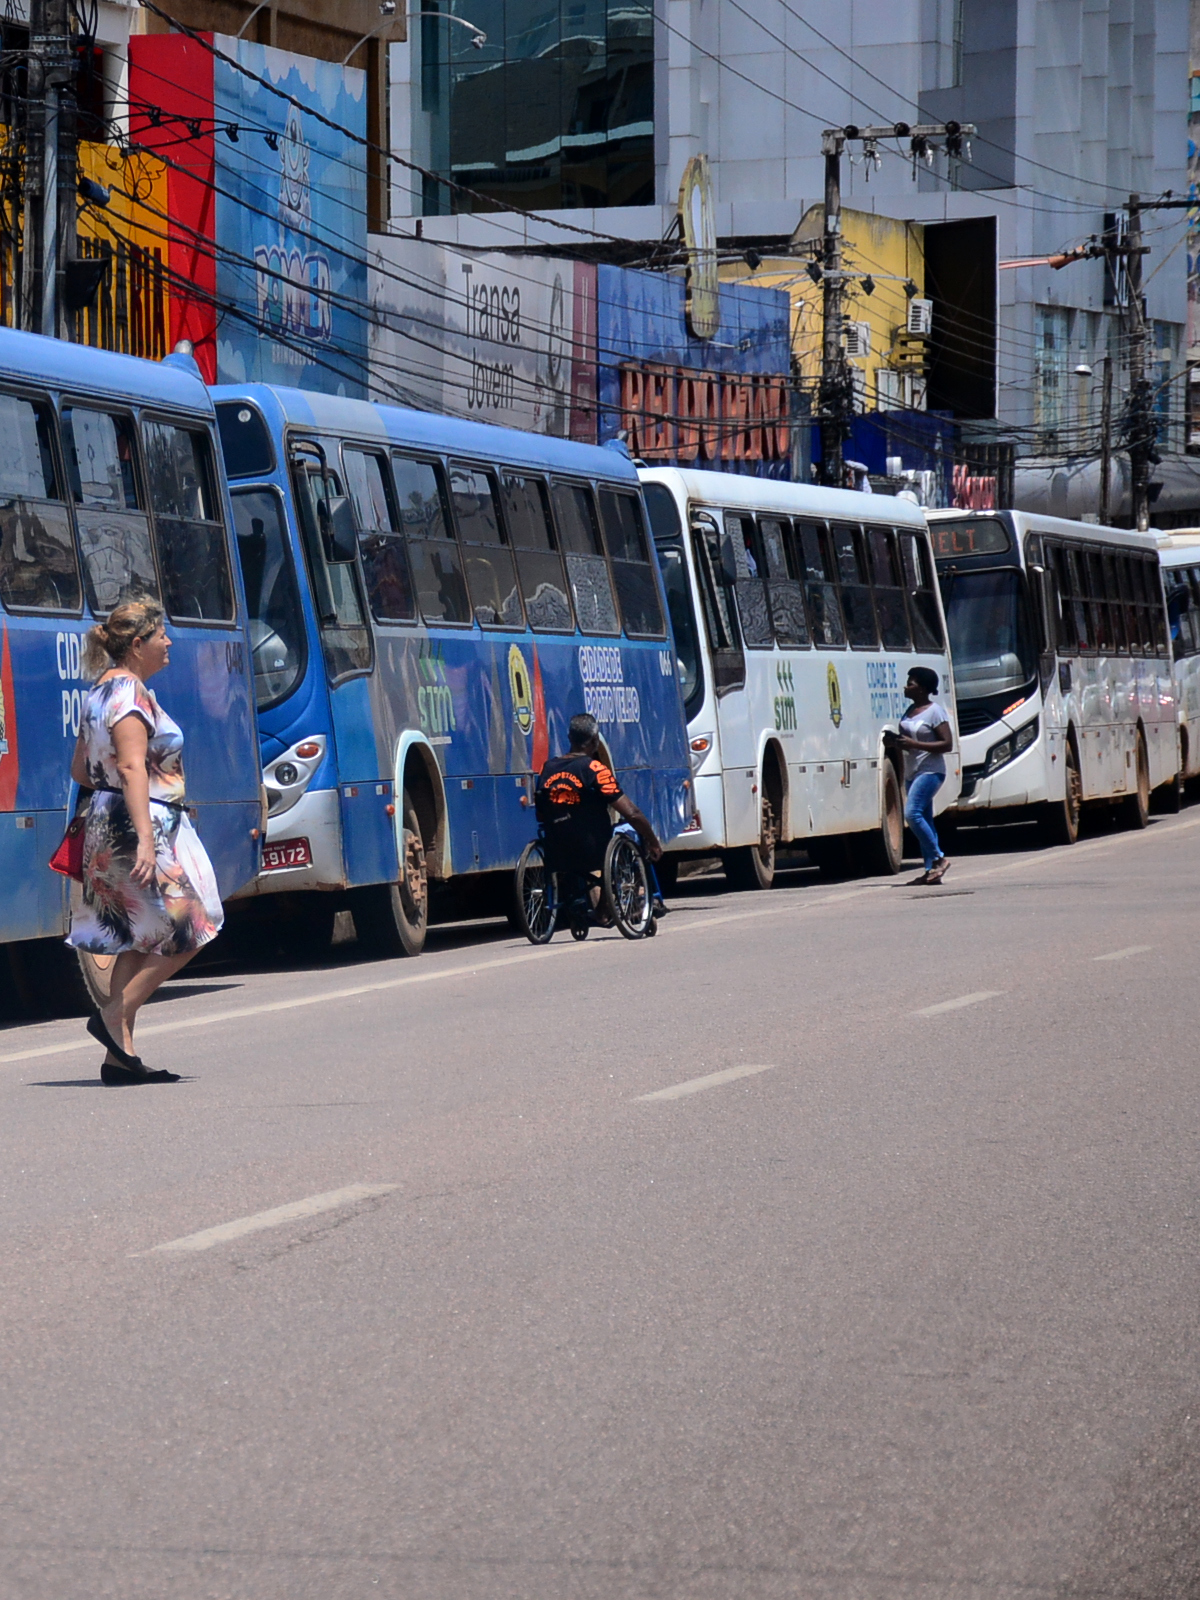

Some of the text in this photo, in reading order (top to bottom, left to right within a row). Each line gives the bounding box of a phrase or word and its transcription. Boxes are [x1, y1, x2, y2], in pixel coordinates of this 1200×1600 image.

[461, 263, 521, 343] Transa
[467, 347, 514, 410] Jovem
[659, 650, 672, 676] 066
[418, 685, 456, 734] sim
[774, 695, 798, 731] sim
